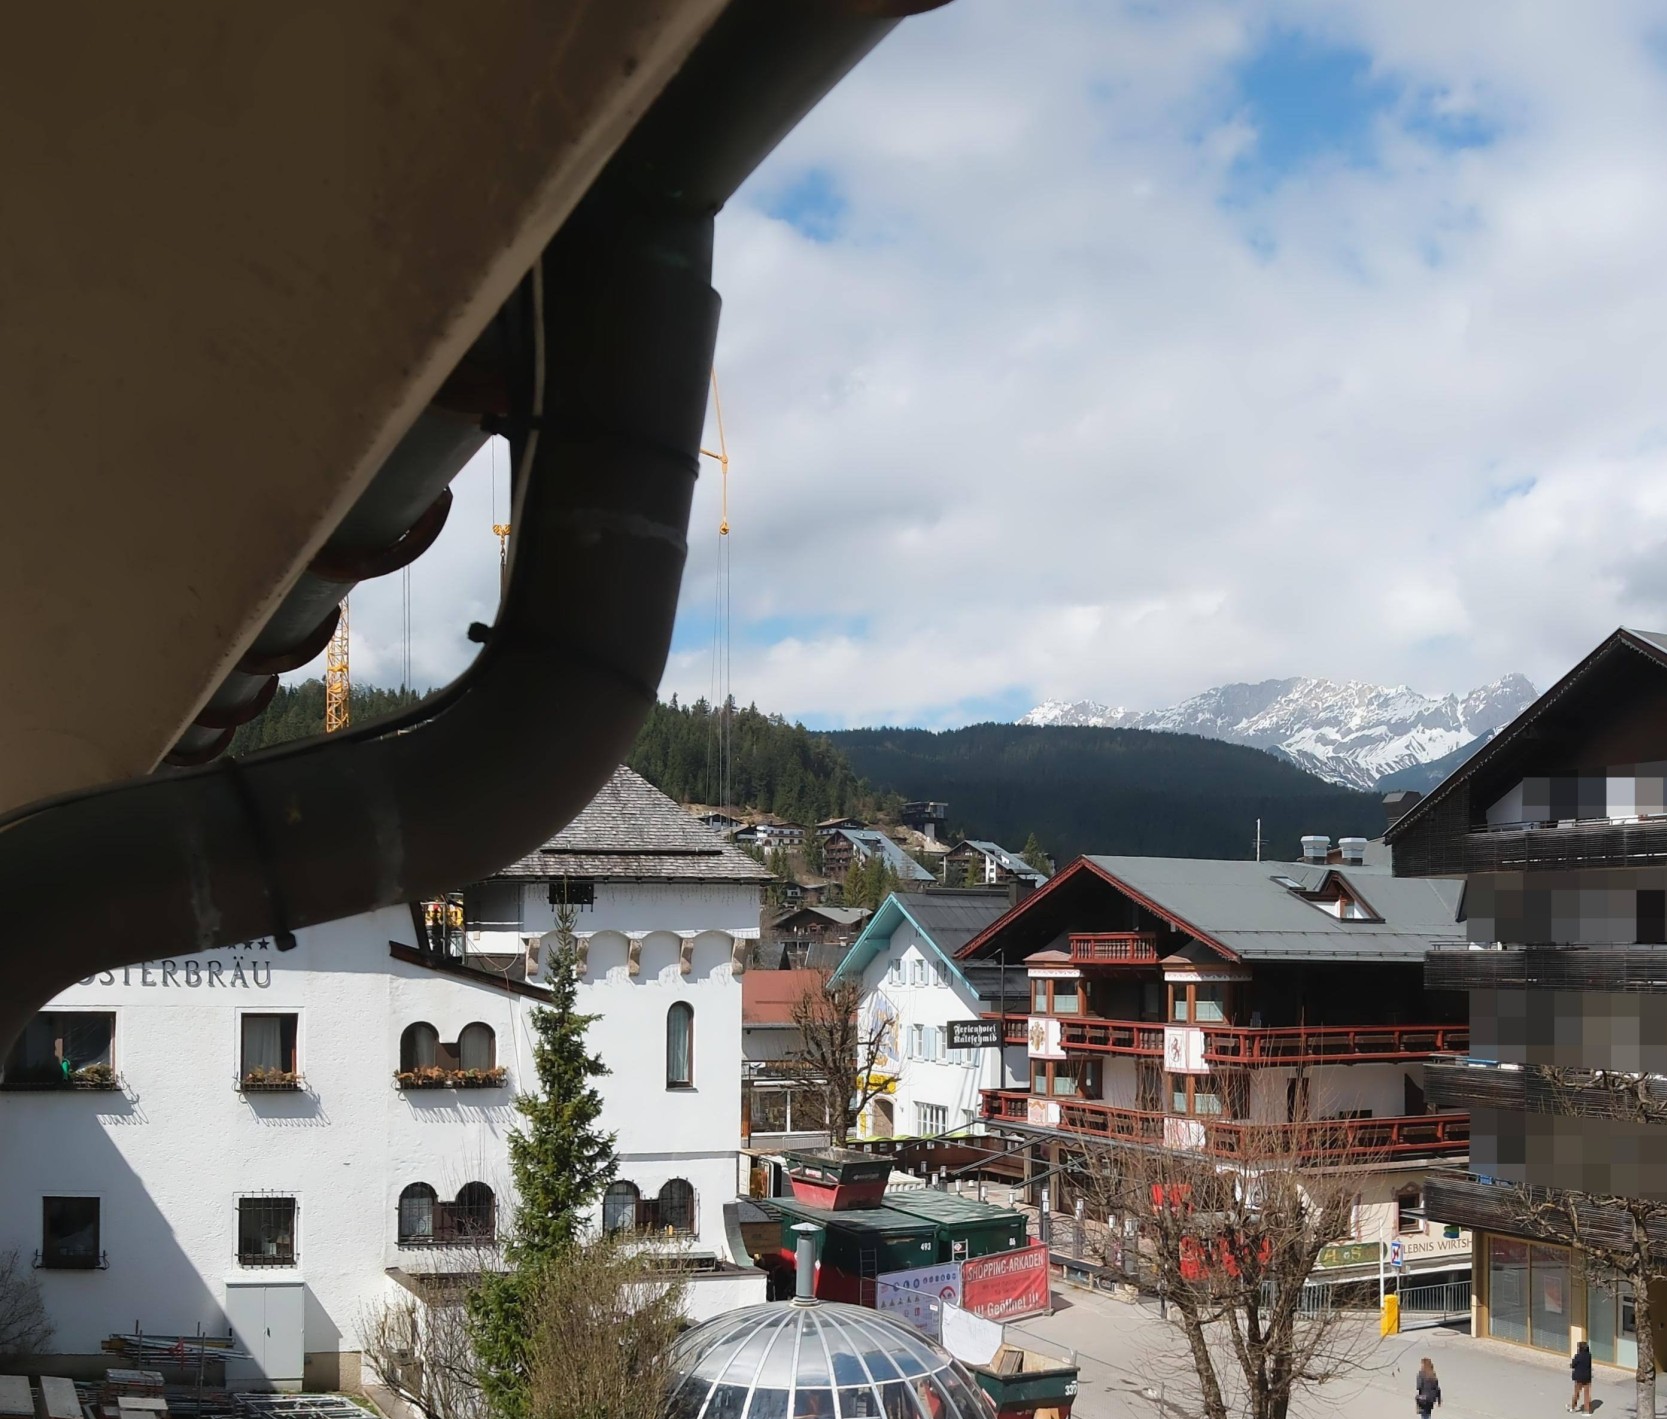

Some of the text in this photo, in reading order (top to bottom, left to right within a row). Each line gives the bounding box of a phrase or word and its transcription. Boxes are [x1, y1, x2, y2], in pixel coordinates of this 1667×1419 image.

[78, 956, 272, 989] STERBRÄU
[1401, 1241, 1435, 1254] LEBNIS
[967, 1252, 1045, 1282] SHOPPING-ARKADEN
